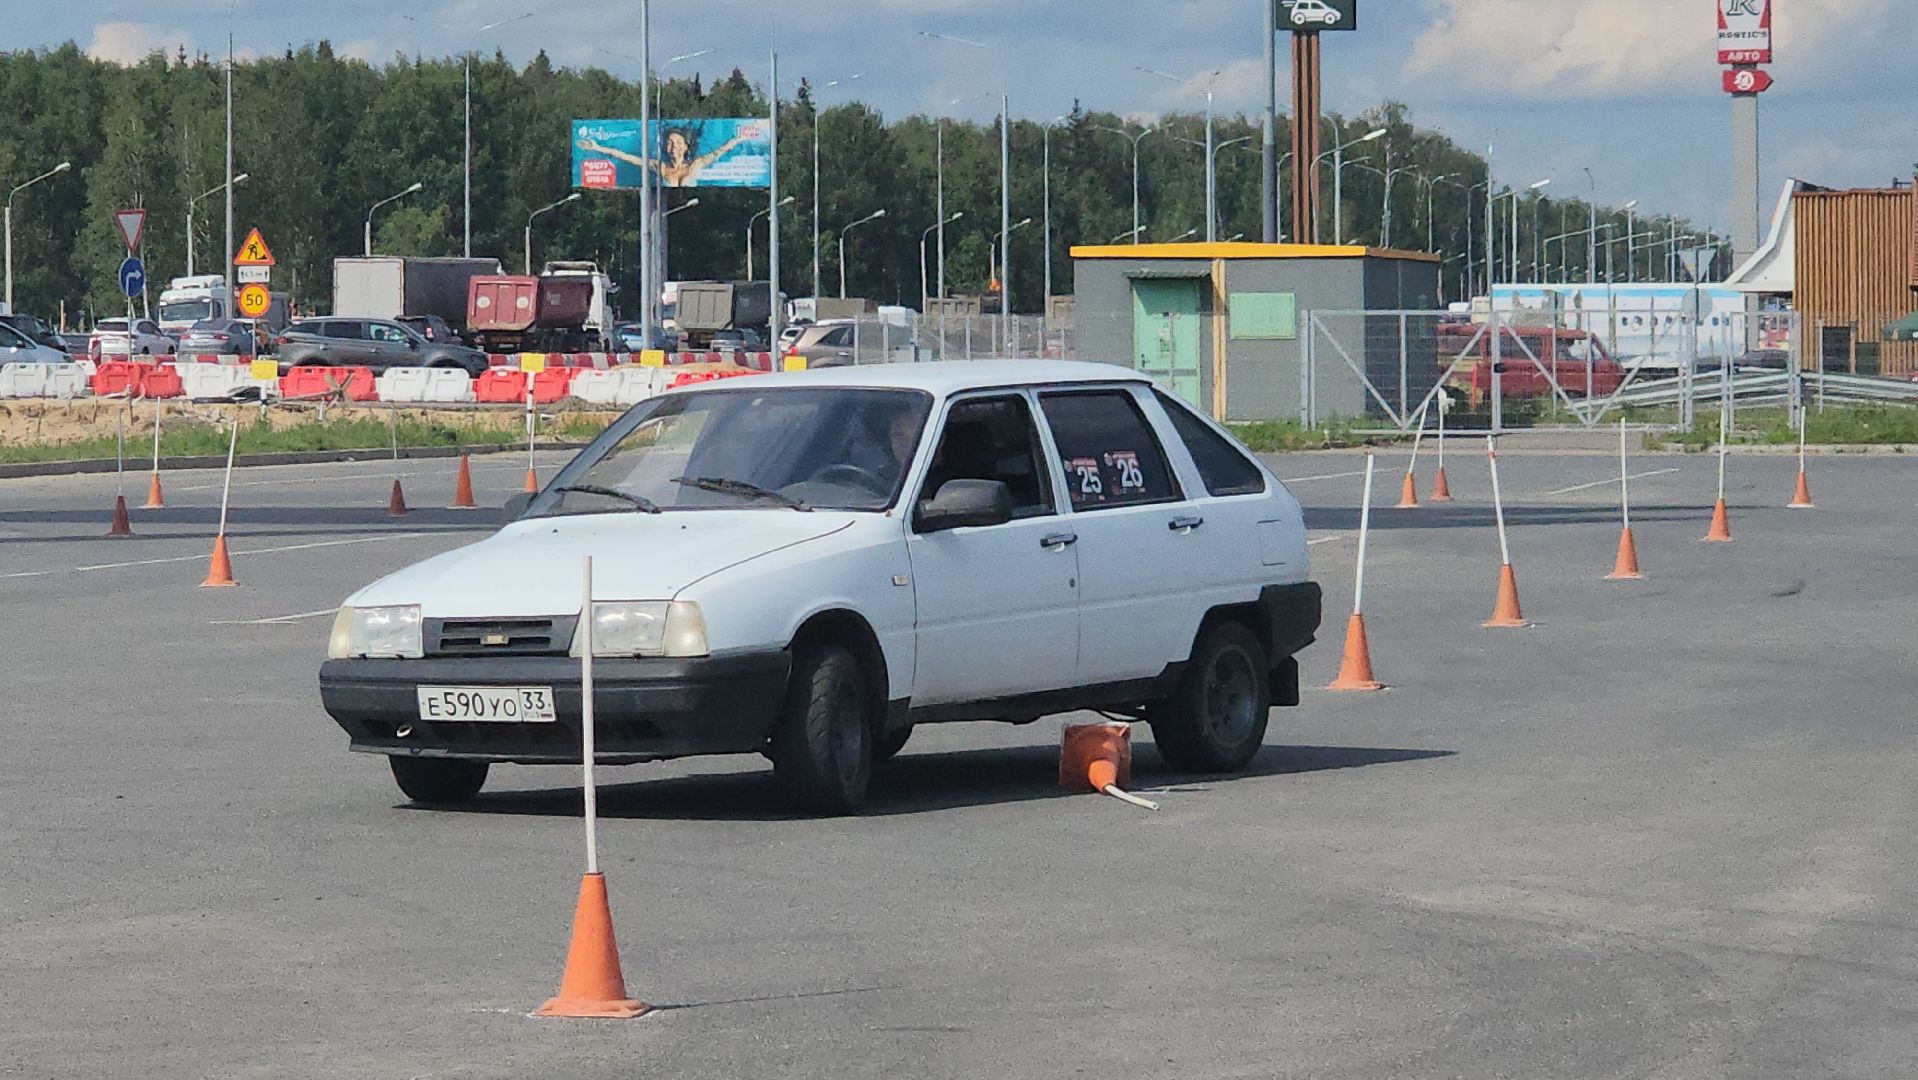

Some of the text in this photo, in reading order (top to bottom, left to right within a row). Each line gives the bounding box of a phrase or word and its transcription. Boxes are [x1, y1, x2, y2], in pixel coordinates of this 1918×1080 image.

[1718, 31, 1767, 39] ROSTIC'S
[246, 293, 263, 306] 50
[1077, 466, 1102, 494] 25
[1117, 458, 1143, 487] 26
[522, 691, 546, 710] 33
